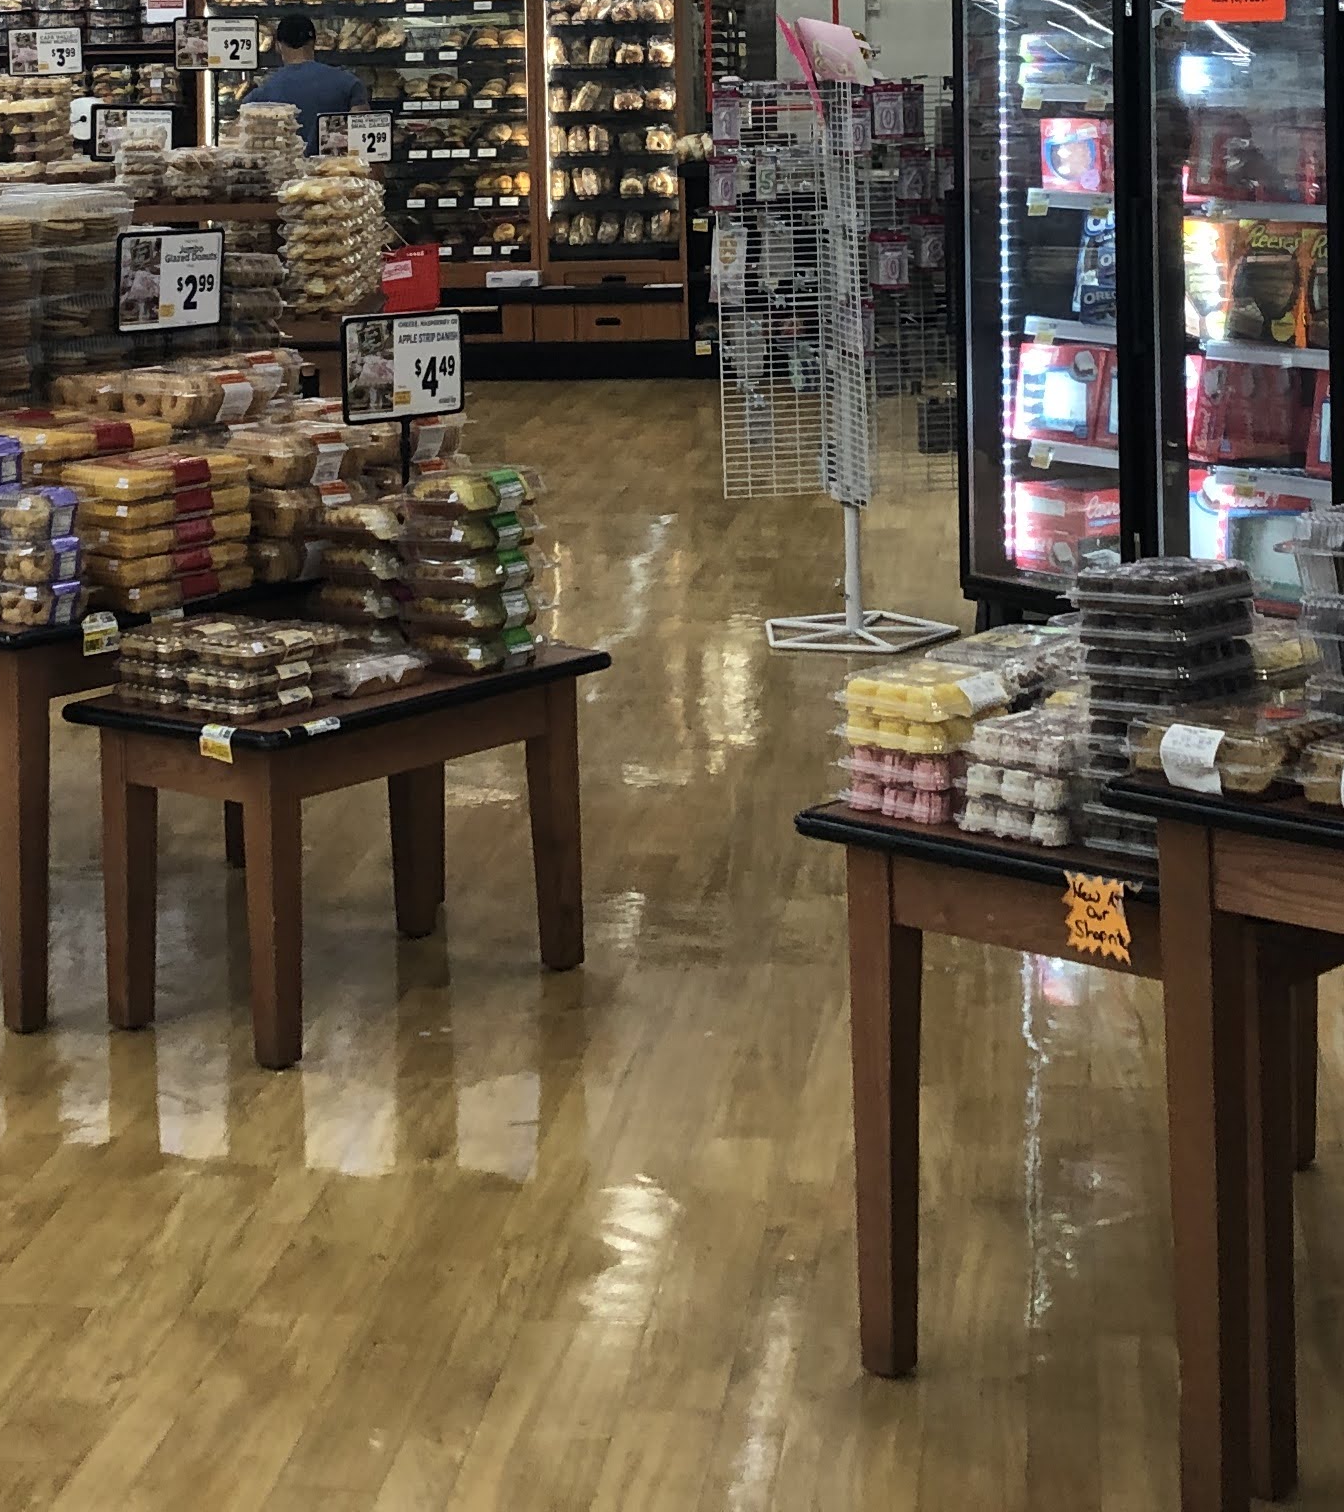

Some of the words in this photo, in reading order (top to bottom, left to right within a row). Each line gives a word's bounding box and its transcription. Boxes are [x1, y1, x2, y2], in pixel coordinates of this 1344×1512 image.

[164, 253, 190, 263] Glazed
[192, 252, 217, 261] Donuts
[398, 333, 418, 345] APPLE
[1072, 881, 1101, 903] New
[1085, 904, 1110, 921] Our
